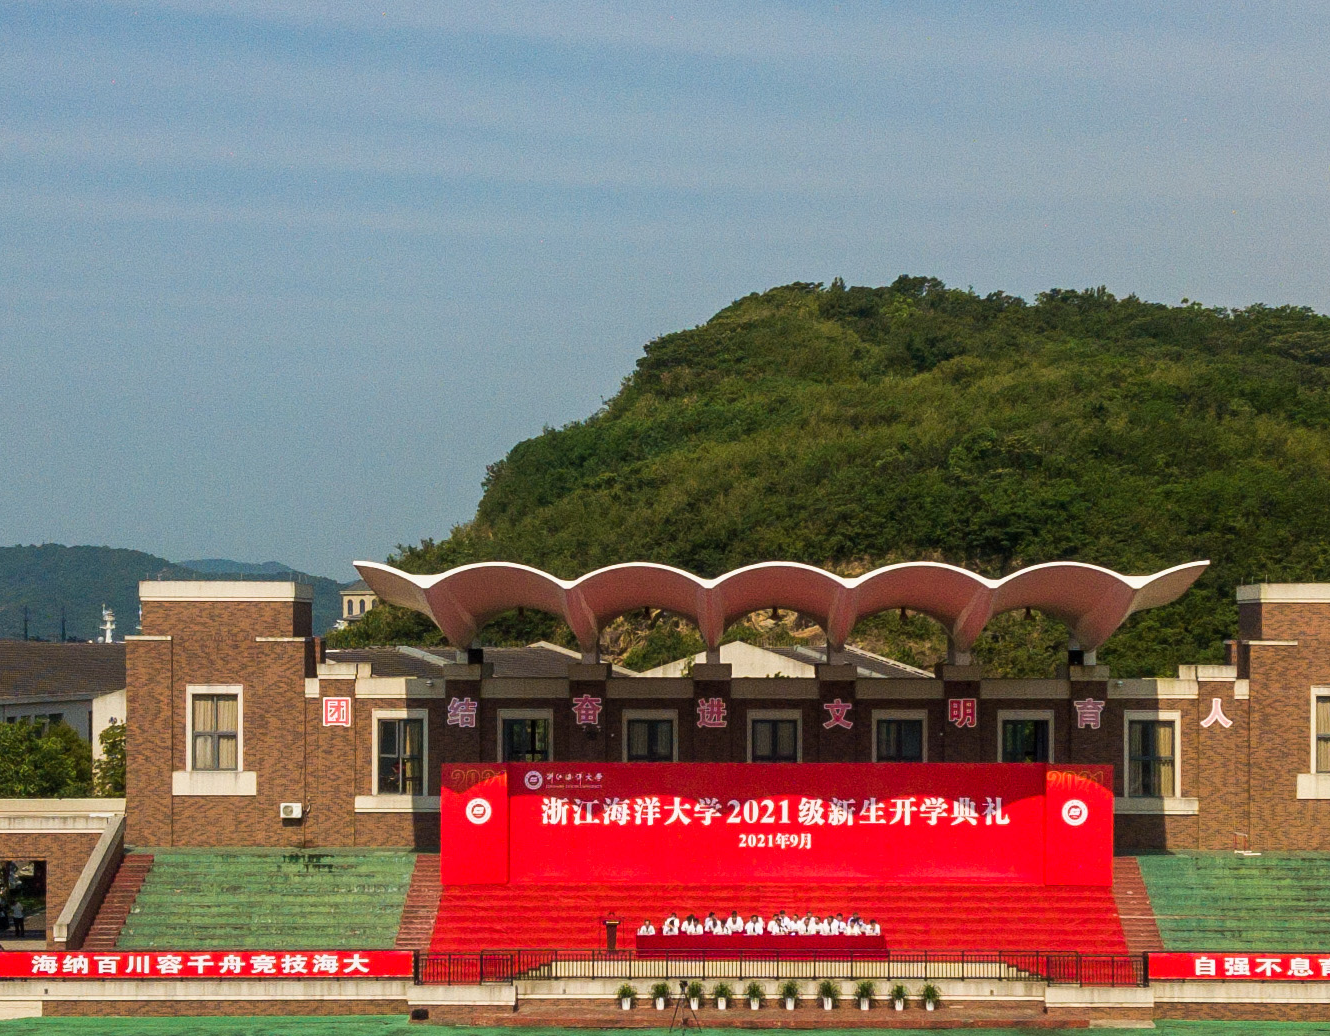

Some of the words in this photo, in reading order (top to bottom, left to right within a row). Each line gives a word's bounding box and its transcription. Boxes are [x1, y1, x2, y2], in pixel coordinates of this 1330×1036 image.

[322, 694, 1233, 728] 团结奋进文明育人
[541, 797, 1010, 826] 浙江海洋大学2021级新生开学典礼
[738, 833, 812, 849] 2021年9月
[31, 954, 370, 975] 海纳百川容千舟竞技海大
